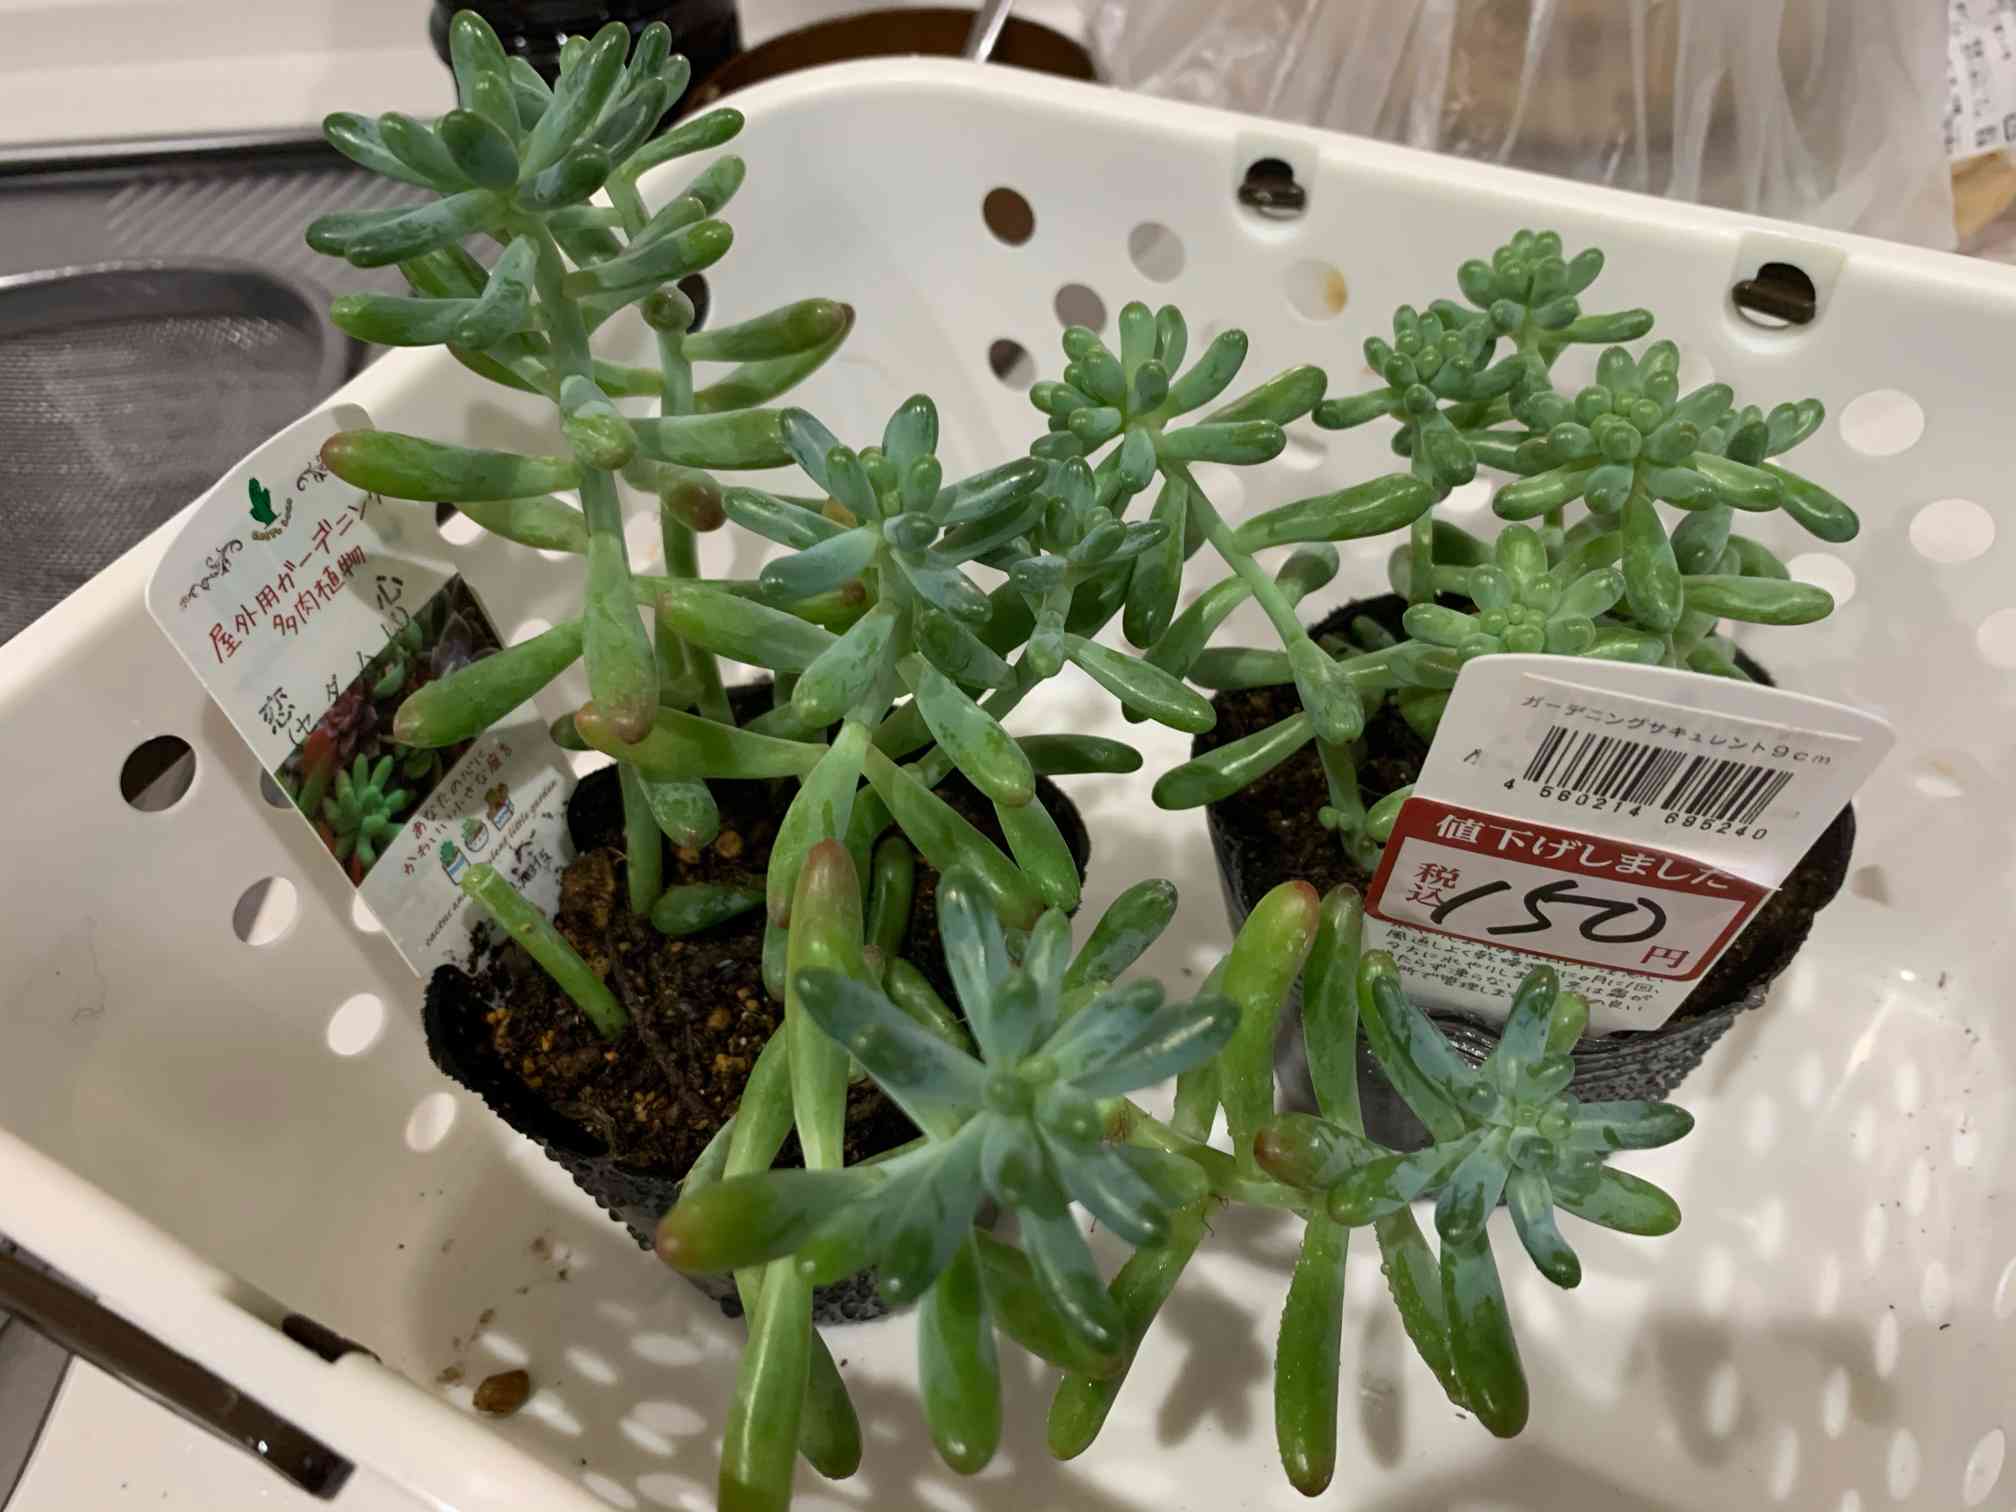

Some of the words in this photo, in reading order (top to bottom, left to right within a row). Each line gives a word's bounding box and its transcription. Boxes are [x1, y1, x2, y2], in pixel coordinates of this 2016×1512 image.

[272, 545, 367, 636] 多肉植物
[1521, 694, 1831, 766] ガーデニングサキュレント9cm
[1503, 777, 1517, 791] 4
[1539, 785, 1641, 818] 560214
[1663, 811, 1768, 841] 695240
[1435, 813, 1729, 890] 値下げしました
[1406, 862, 1462, 909] 税込
[1430, 880, 1667, 943] 150
[1639, 944, 1691, 969] 円
